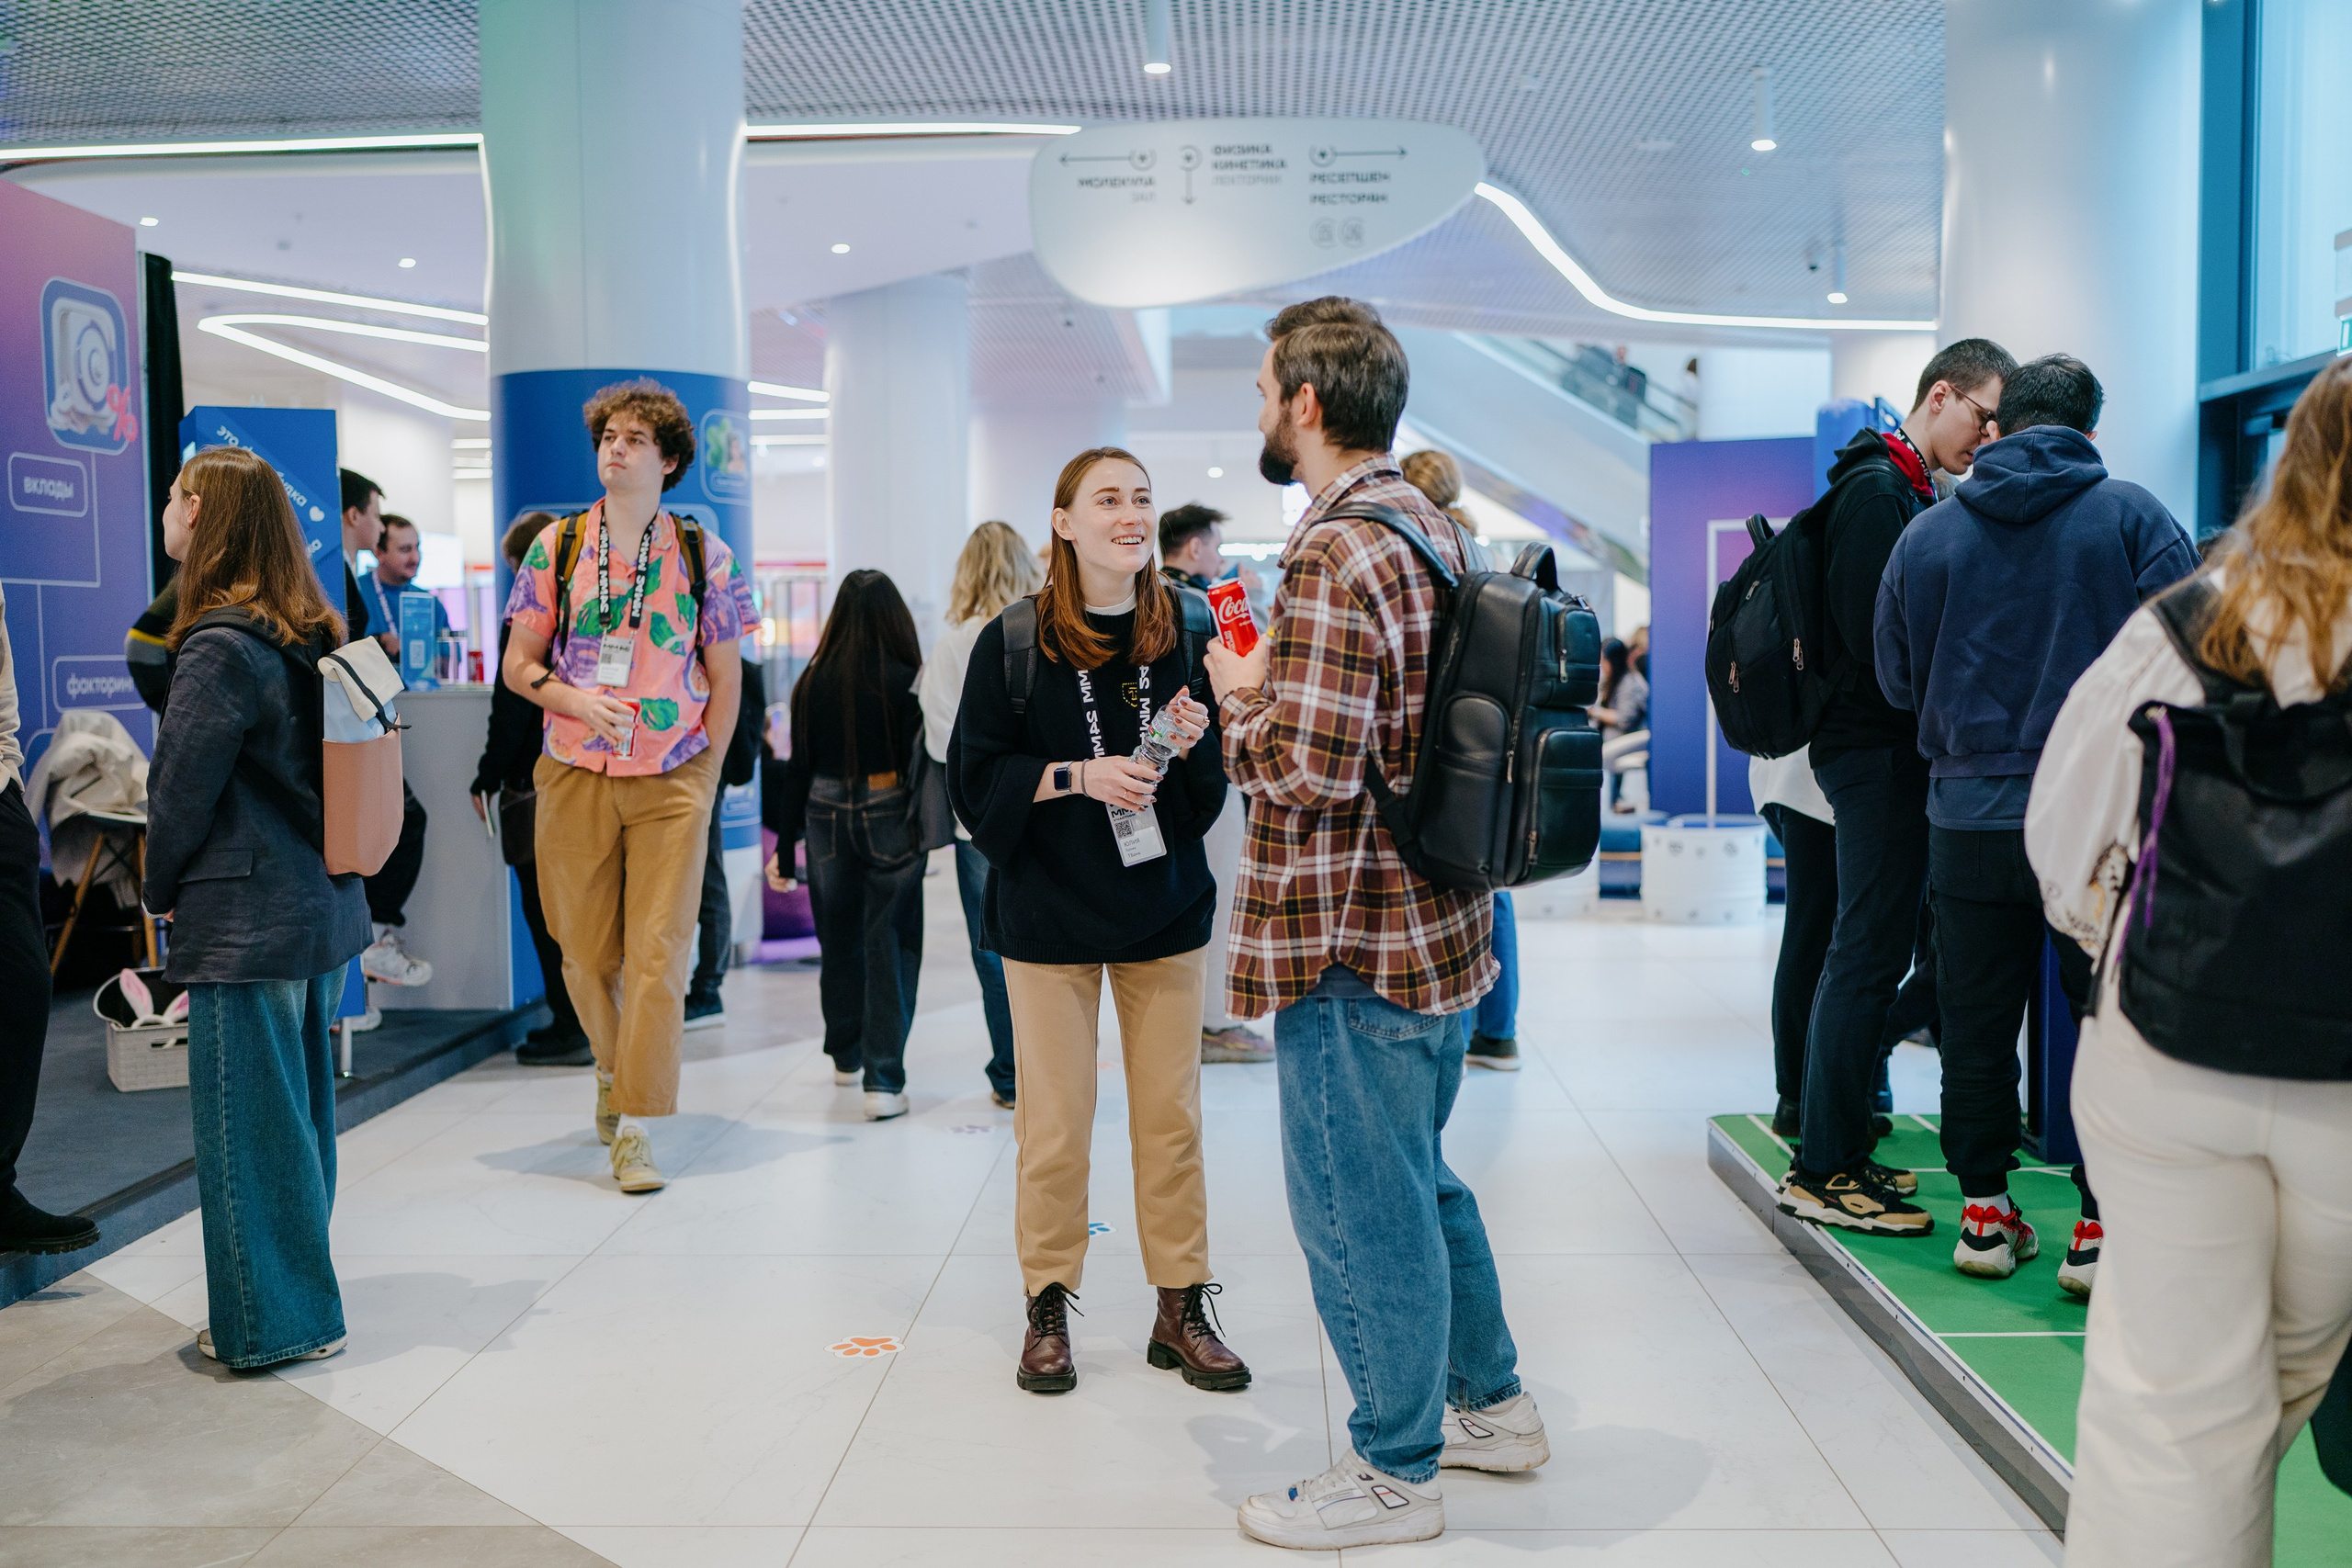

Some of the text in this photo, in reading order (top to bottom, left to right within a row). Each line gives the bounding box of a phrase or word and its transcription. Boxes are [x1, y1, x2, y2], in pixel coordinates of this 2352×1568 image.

[216, 425, 239, 446] это
[23, 476, 74, 501] вклады
[67, 672, 135, 700] факторин
[1124, 838, 1140, 847] ЮЛИЯ
